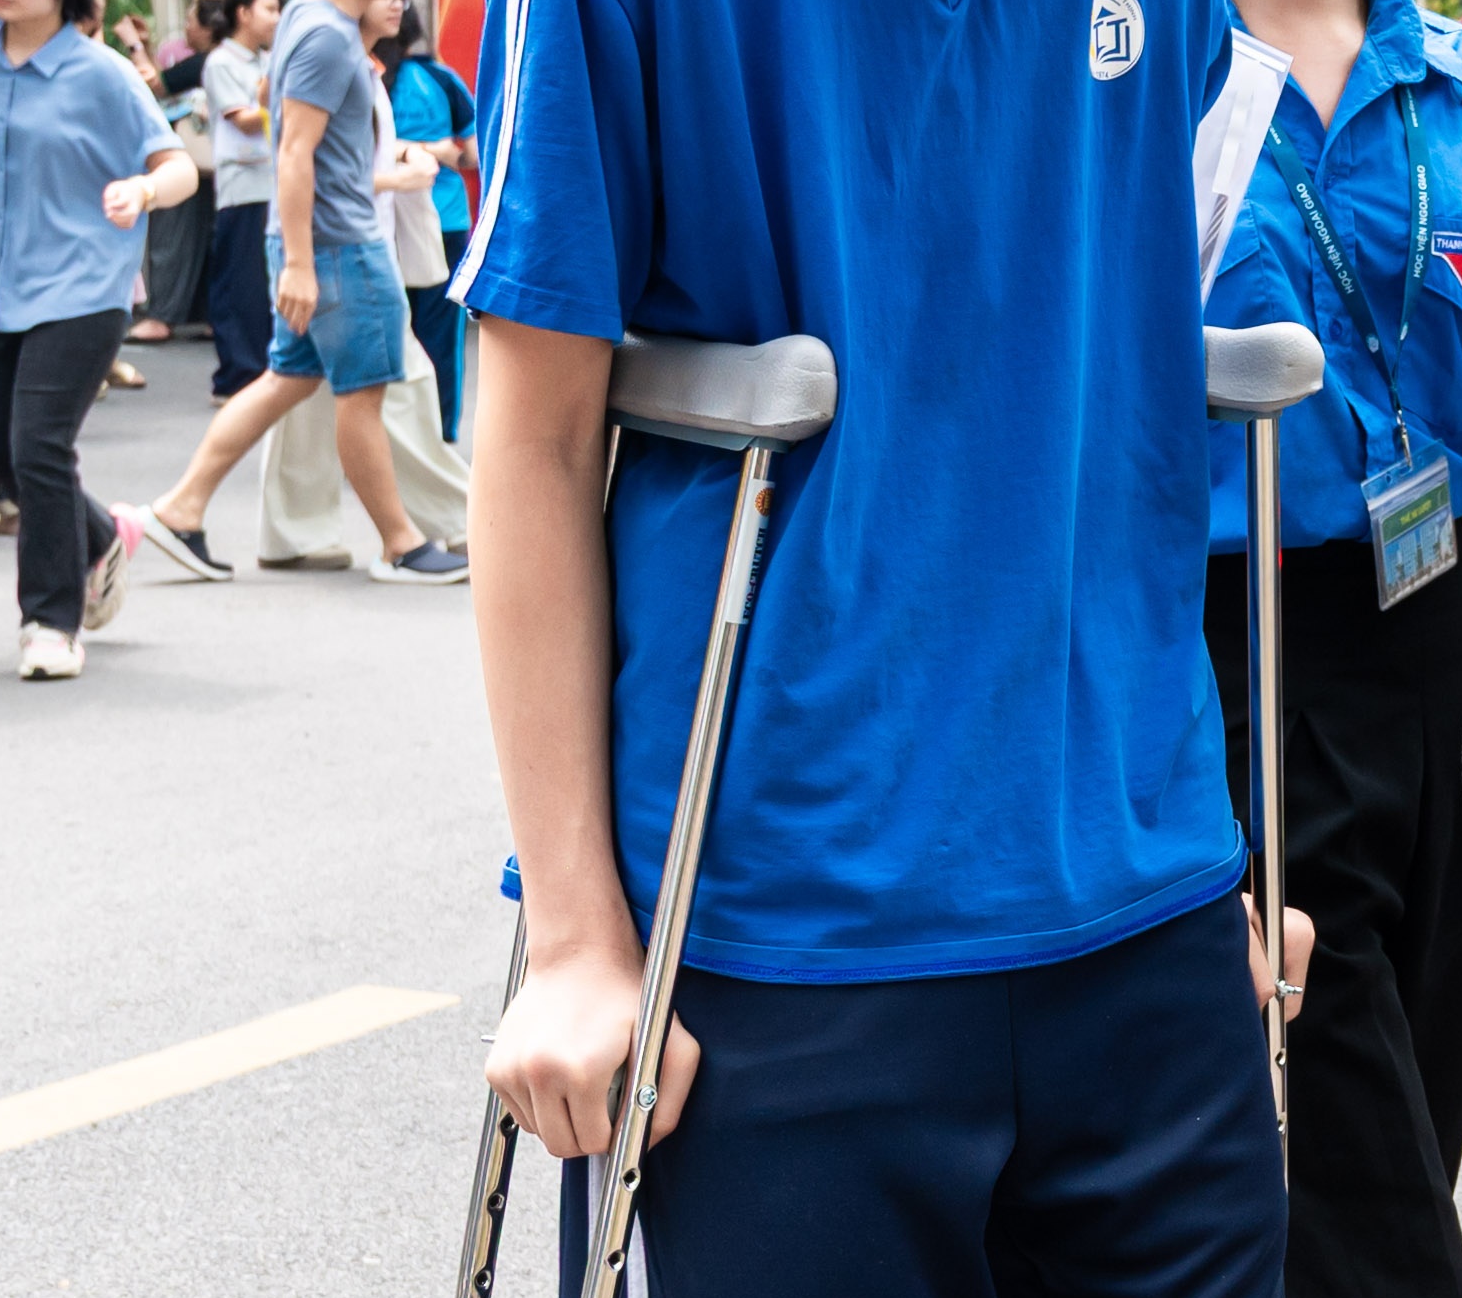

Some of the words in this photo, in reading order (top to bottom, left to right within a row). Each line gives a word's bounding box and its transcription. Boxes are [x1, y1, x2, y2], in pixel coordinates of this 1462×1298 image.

[1416, 164, 1428, 191] GIAO
[1296, 182, 1317, 211] GIAO
[1418, 191, 1430, 225] NGOẠI
[1309, 211, 1333, 245] NGOẠI
[1416, 225, 1429, 253] VIỆN
[1326, 244, 1345, 272] VIỆN
[1413, 254, 1425, 279] HỌC
[1338, 267, 1355, 296] HỌC
